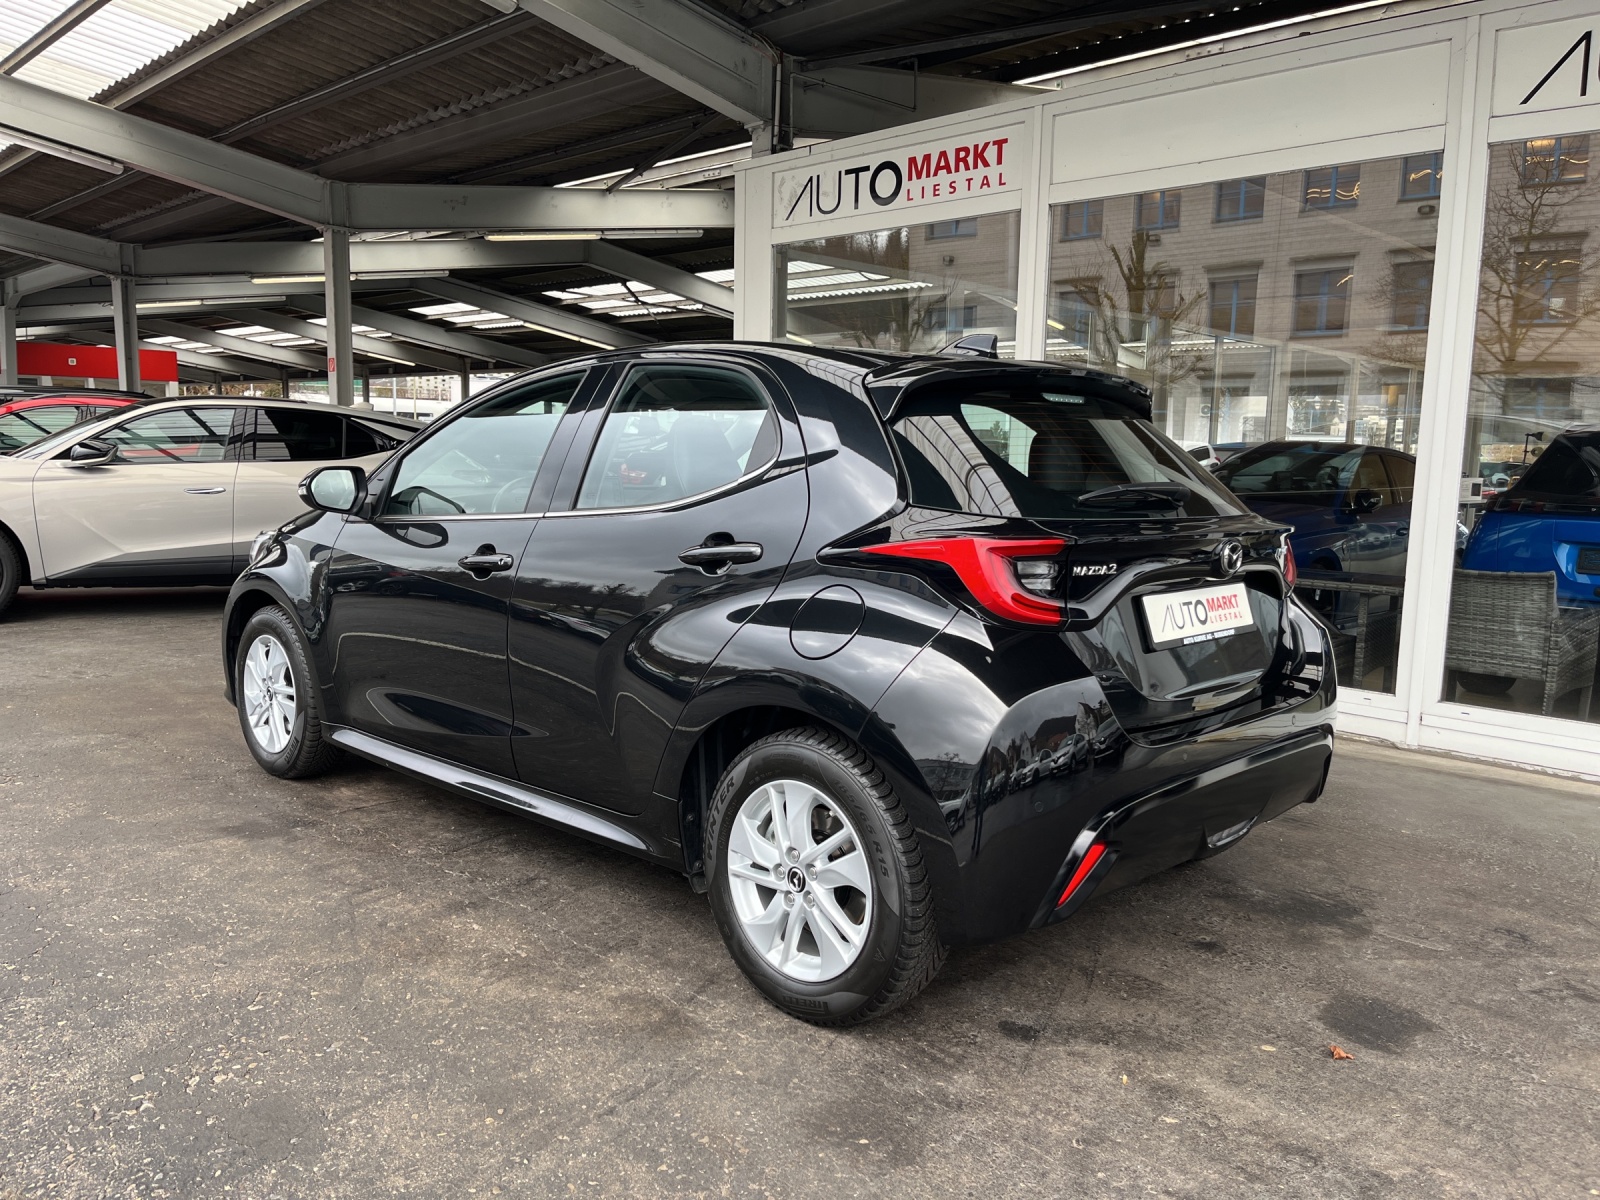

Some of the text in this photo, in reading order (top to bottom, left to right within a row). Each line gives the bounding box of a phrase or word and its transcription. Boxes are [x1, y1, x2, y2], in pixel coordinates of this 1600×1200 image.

[1519, 30, 1600, 105] A
[785, 138, 1009, 221] AUTO MARKT
[906, 172, 1007, 202] LIESTAL
[1161, 594, 1239, 633] AUTO MARKT
[1210, 611, 1243, 624] LIESTAL
[706, 775, 735, 861] WINTER
[872, 840, 890, 879] R15
